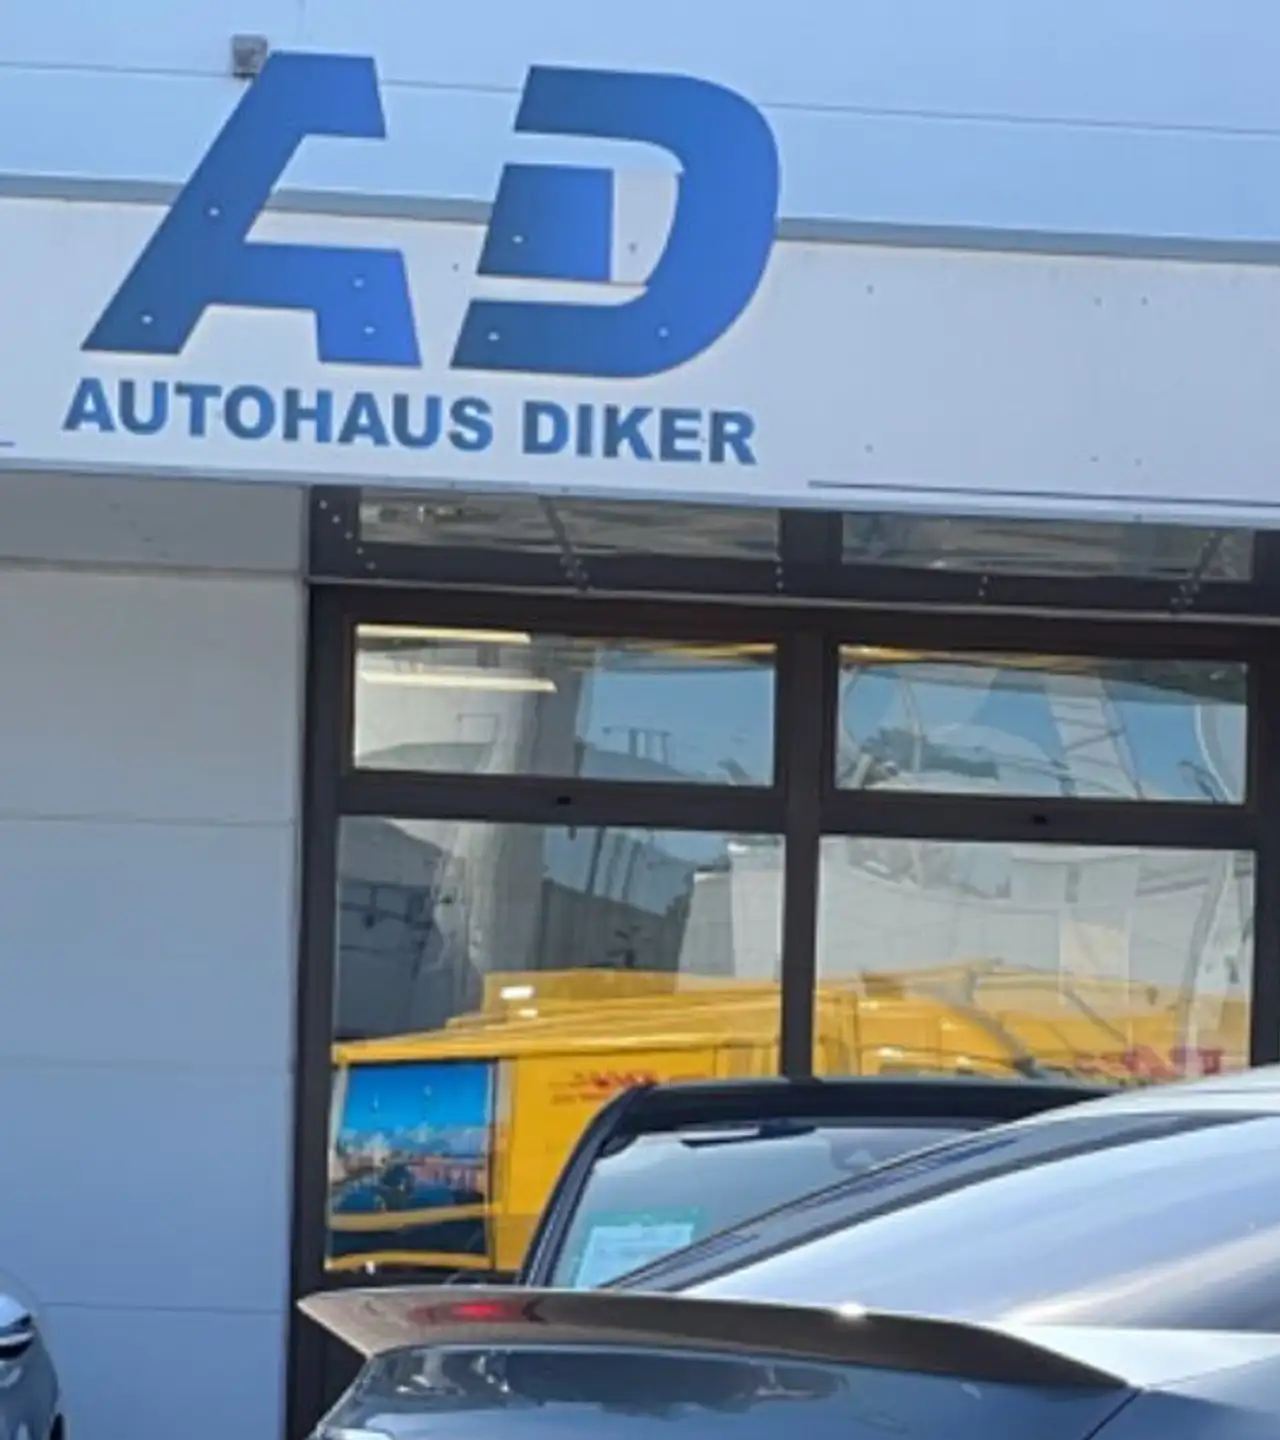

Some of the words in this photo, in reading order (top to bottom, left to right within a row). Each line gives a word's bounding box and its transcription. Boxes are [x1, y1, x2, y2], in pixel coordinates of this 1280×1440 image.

[81, 49, 779, 379] AD
[63, 376, 494, 452] AUTOHAUS
[521, 401, 758, 466] DIKER
